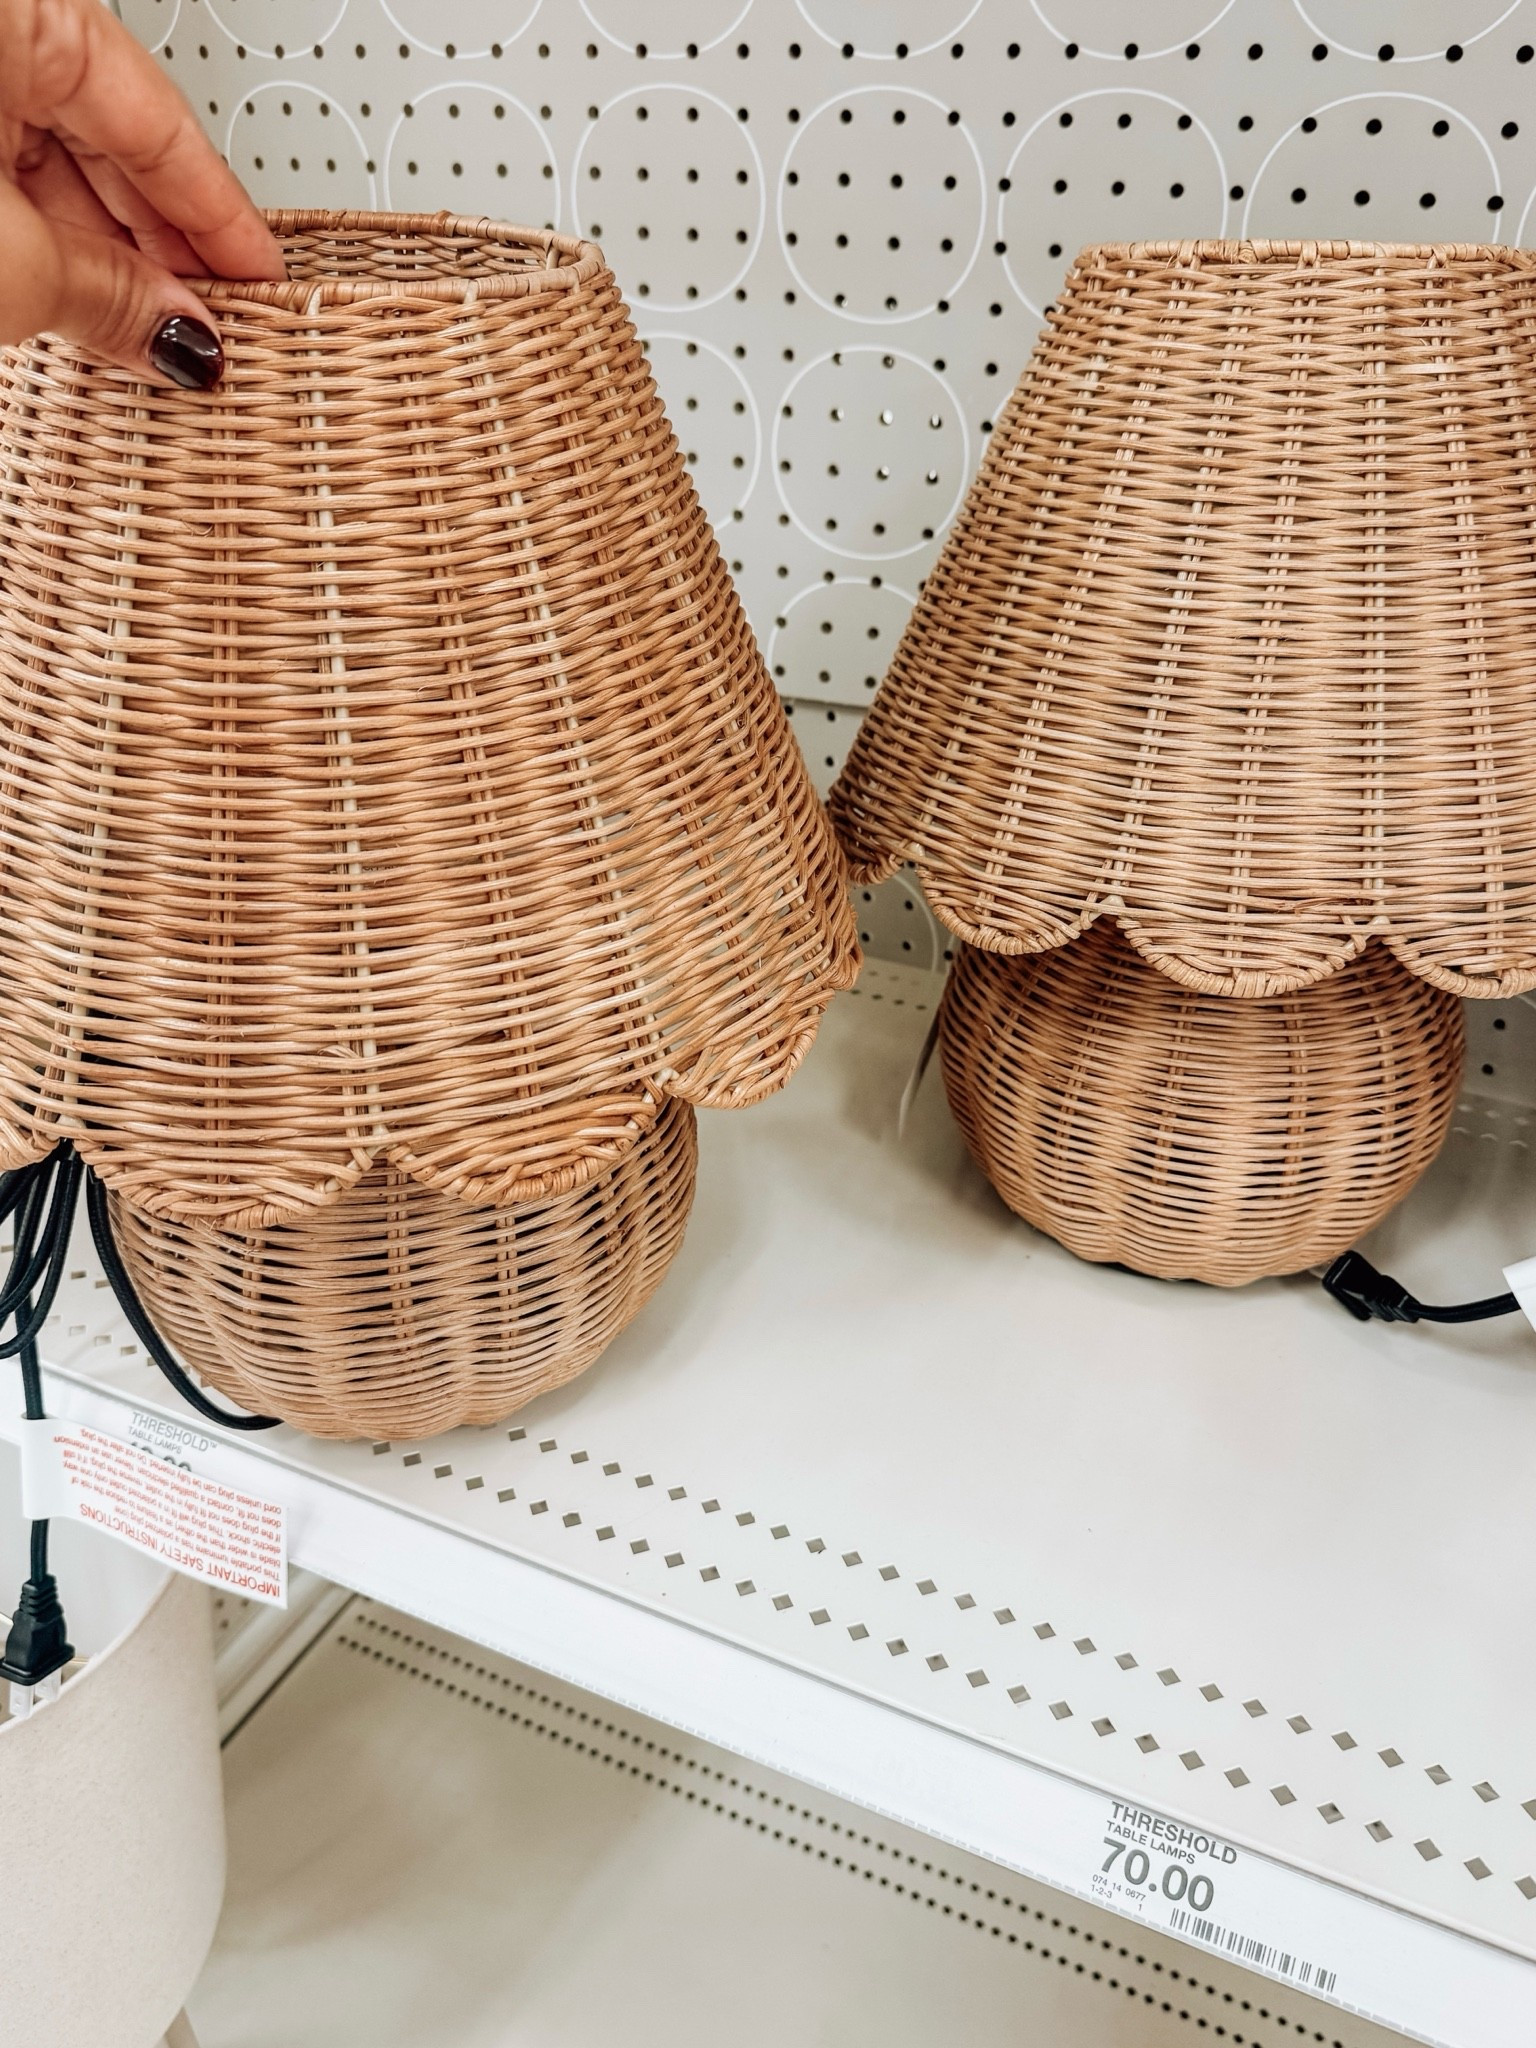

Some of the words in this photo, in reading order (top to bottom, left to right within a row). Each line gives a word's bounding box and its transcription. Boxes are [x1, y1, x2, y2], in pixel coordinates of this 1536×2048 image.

[129, 1425, 152, 1443] TABLE
[155, 1436, 182, 1454] LAMPS
[80, 1504, 157, 1550] INSTRUCTIONS
[160, 1543, 203, 1571] SAFETY
[207, 1563, 280, 1597] IMPORTANT
[1106, 1820, 1147, 1845] TABLE
[1150, 1838, 1196, 1865] LAMPS
[1112, 1801, 1237, 1865] THRESHOLD
[1092, 1874, 1108, 1886] 074
[1111, 1882, 1122, 1892] 14
[1125, 1888, 1146, 1901] 0677
[1101, 1836, 1214, 1912] 70.00
[1091, 1884, 1113, 1899] 1-2-3
